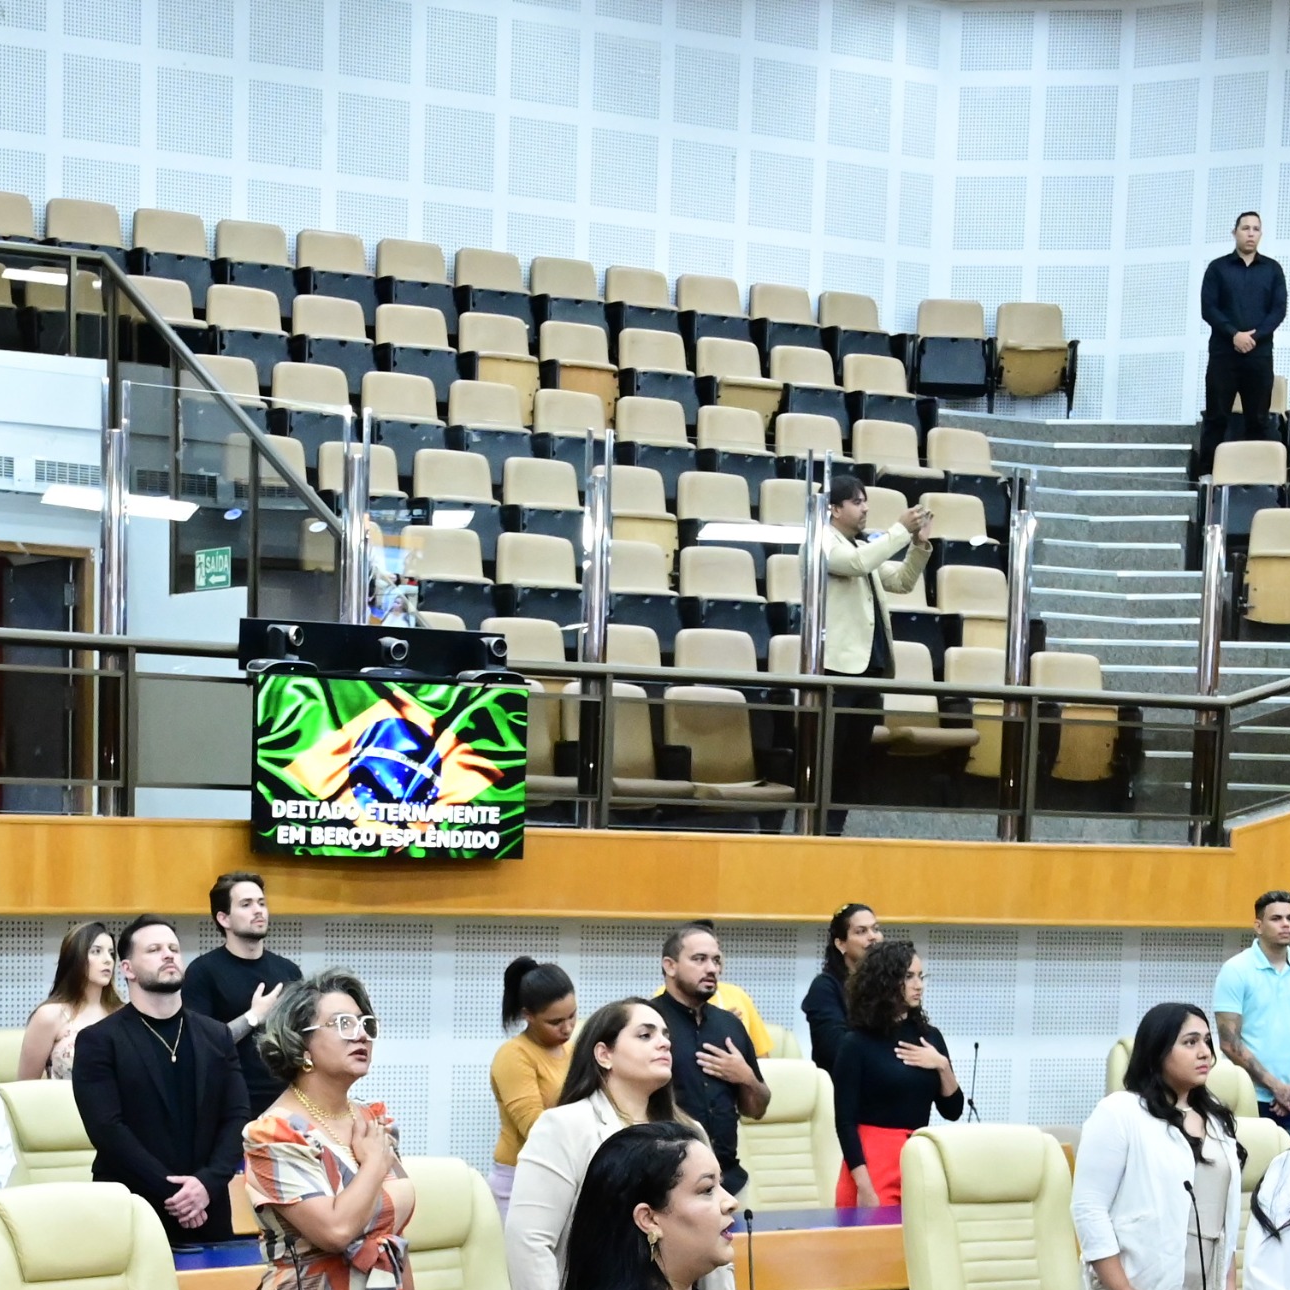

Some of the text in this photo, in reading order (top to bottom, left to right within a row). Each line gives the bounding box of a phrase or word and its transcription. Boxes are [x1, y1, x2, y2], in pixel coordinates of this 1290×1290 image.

[205, 551, 229, 573] SAÍDA
[271, 799, 501, 825] DEITADO ETERNAMENTE
[277, 825, 500, 850] EM BERÇO ESPLÊNDIDO
